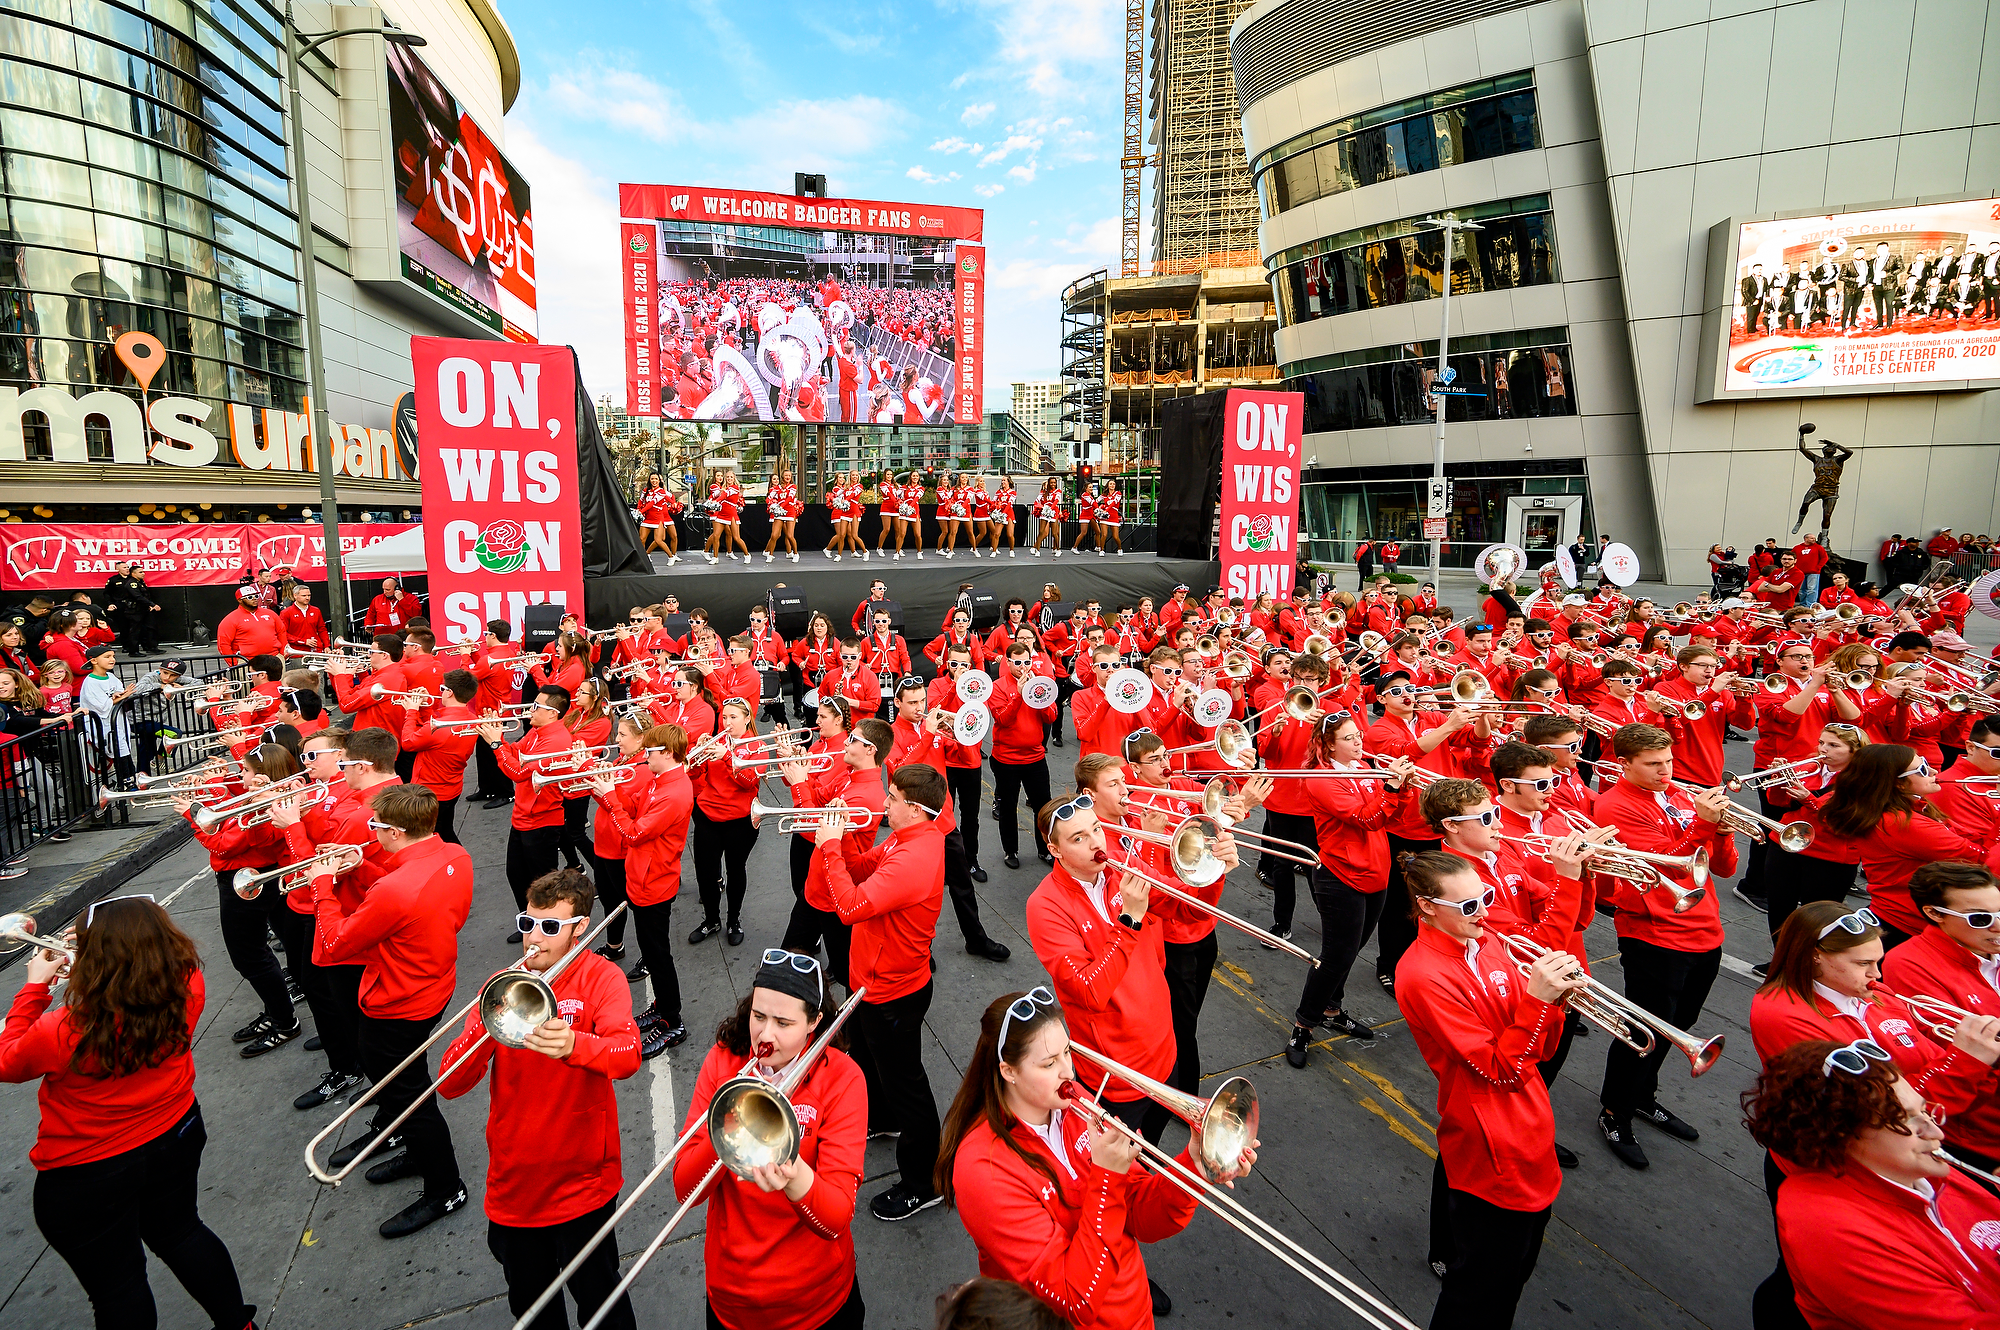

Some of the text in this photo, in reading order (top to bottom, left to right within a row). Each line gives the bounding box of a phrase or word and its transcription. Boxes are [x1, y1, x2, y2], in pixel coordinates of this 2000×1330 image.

[702, 196, 912, 229] WELCOME BADGER FANS
[1801, 222, 1916, 244] STAPLES Center
[633, 262, 651, 413] ROSE BOWL GAME 2020
[962, 281, 975, 421] ROSE BOWL GAME 2020
[1833, 353, 1846, 364] 14
[1850, 352, 1858, 363] Y
[1863, 351, 1877, 363] 15
[1880, 350, 1896, 362] DE
[1962, 344, 1996, 358] 2020
[1848, 343, 1879, 351] DEMANDA
[1880, 341, 1910, 350] POPULAR
[1911, 339, 1941, 349] SEGUNDA
[1943, 337, 1965, 346] FECHA
[1832, 360, 1936, 377] STAPLES CENTER
[437, 356, 562, 440] ON,
[1236, 401, 1296, 459] ON,
[439, 447, 561, 504] WIS
[1233, 464, 1292, 504] WIS
[72, 537, 242, 556] WELCOME
[184, 557, 243, 571] FANS
[1228, 563, 1290, 600] SIN!
